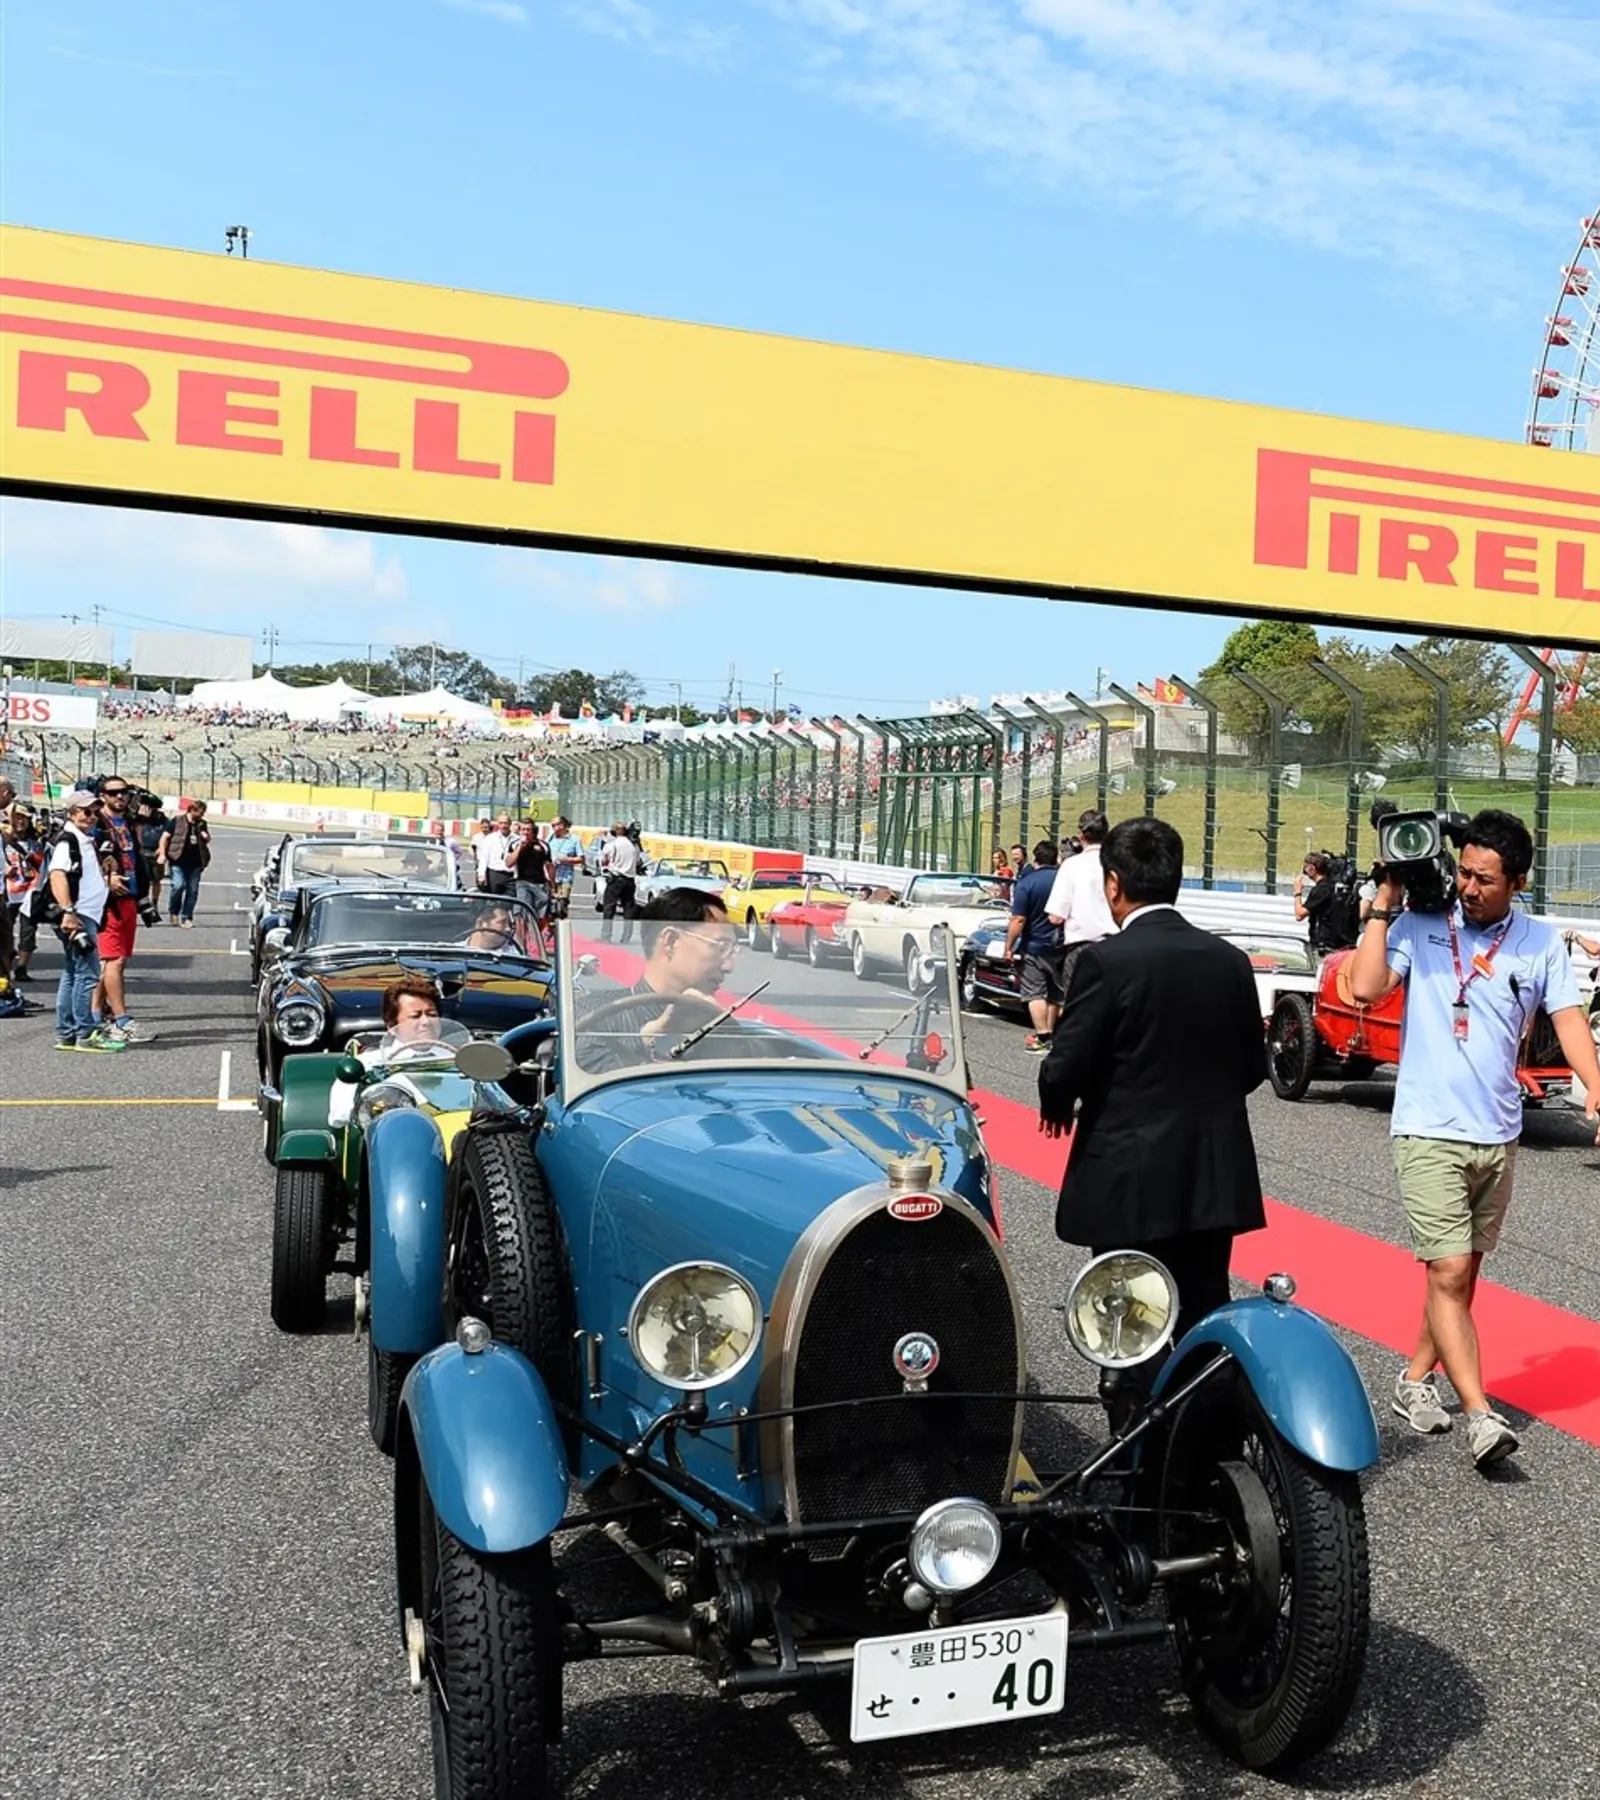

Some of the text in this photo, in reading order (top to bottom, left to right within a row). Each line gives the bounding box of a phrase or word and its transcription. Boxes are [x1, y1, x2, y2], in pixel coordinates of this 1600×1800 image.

[0, 278, 569, 486] RELLI
[3, 697, 51, 722] BS
[895, 1203, 938, 1214] BUGATTI
[992, 1658, 1054, 1711] 40
